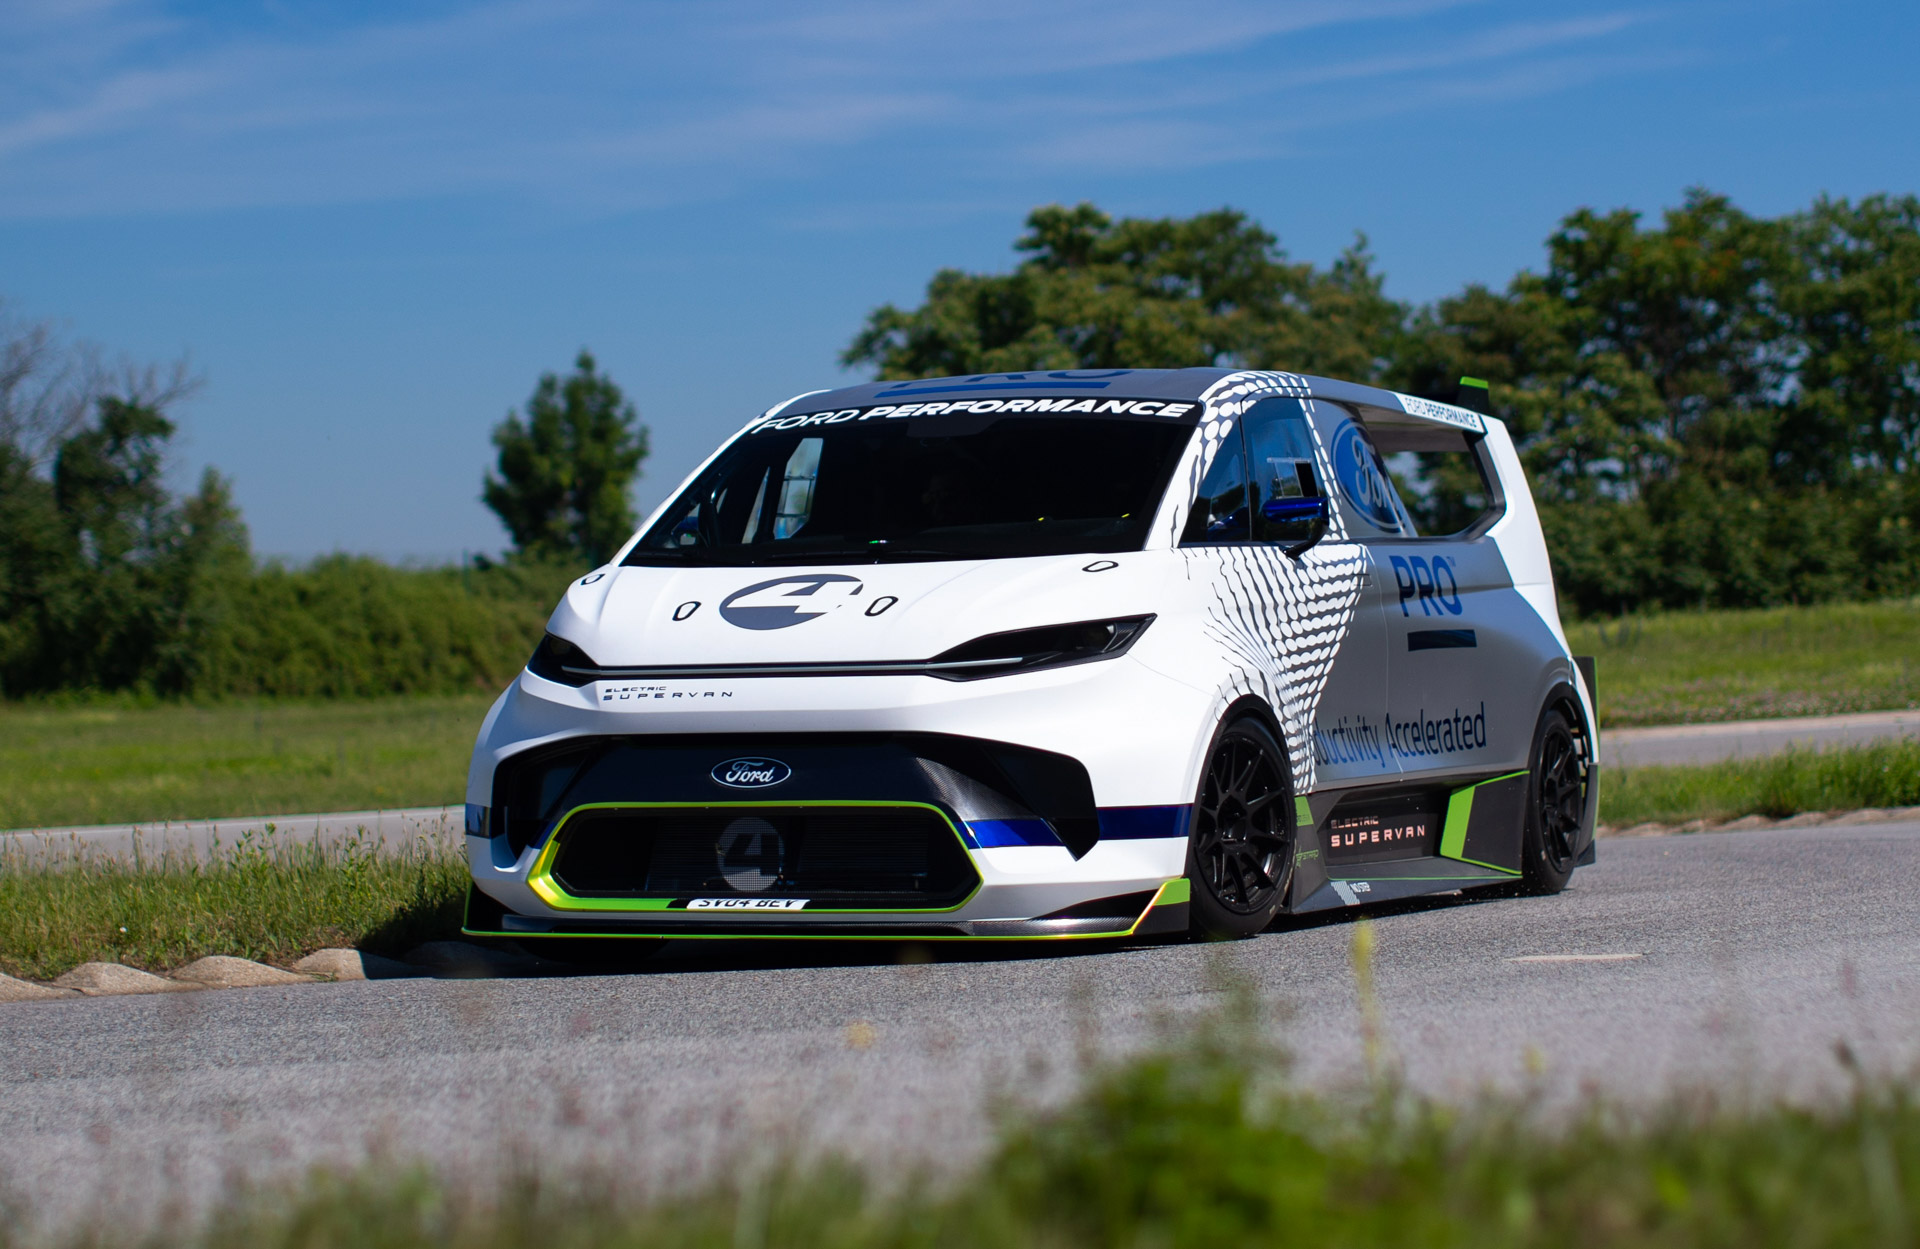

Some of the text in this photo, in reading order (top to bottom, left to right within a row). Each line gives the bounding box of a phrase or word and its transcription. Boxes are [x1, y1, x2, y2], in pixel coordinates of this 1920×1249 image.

[751, 399, 1196, 434] FORD PERFORMANCE
[1424, 402, 1477, 428] PERFORMANCE
[1389, 555, 1463, 617] PRO
[603, 691, 733, 701] SUPERVAN
[1385, 701, 1487, 758] Accelerated
[725, 760, 776, 783] Ford
[1331, 815, 1379, 829] ELECTRIC
[1330, 824, 1426, 847] SUPERVAN
